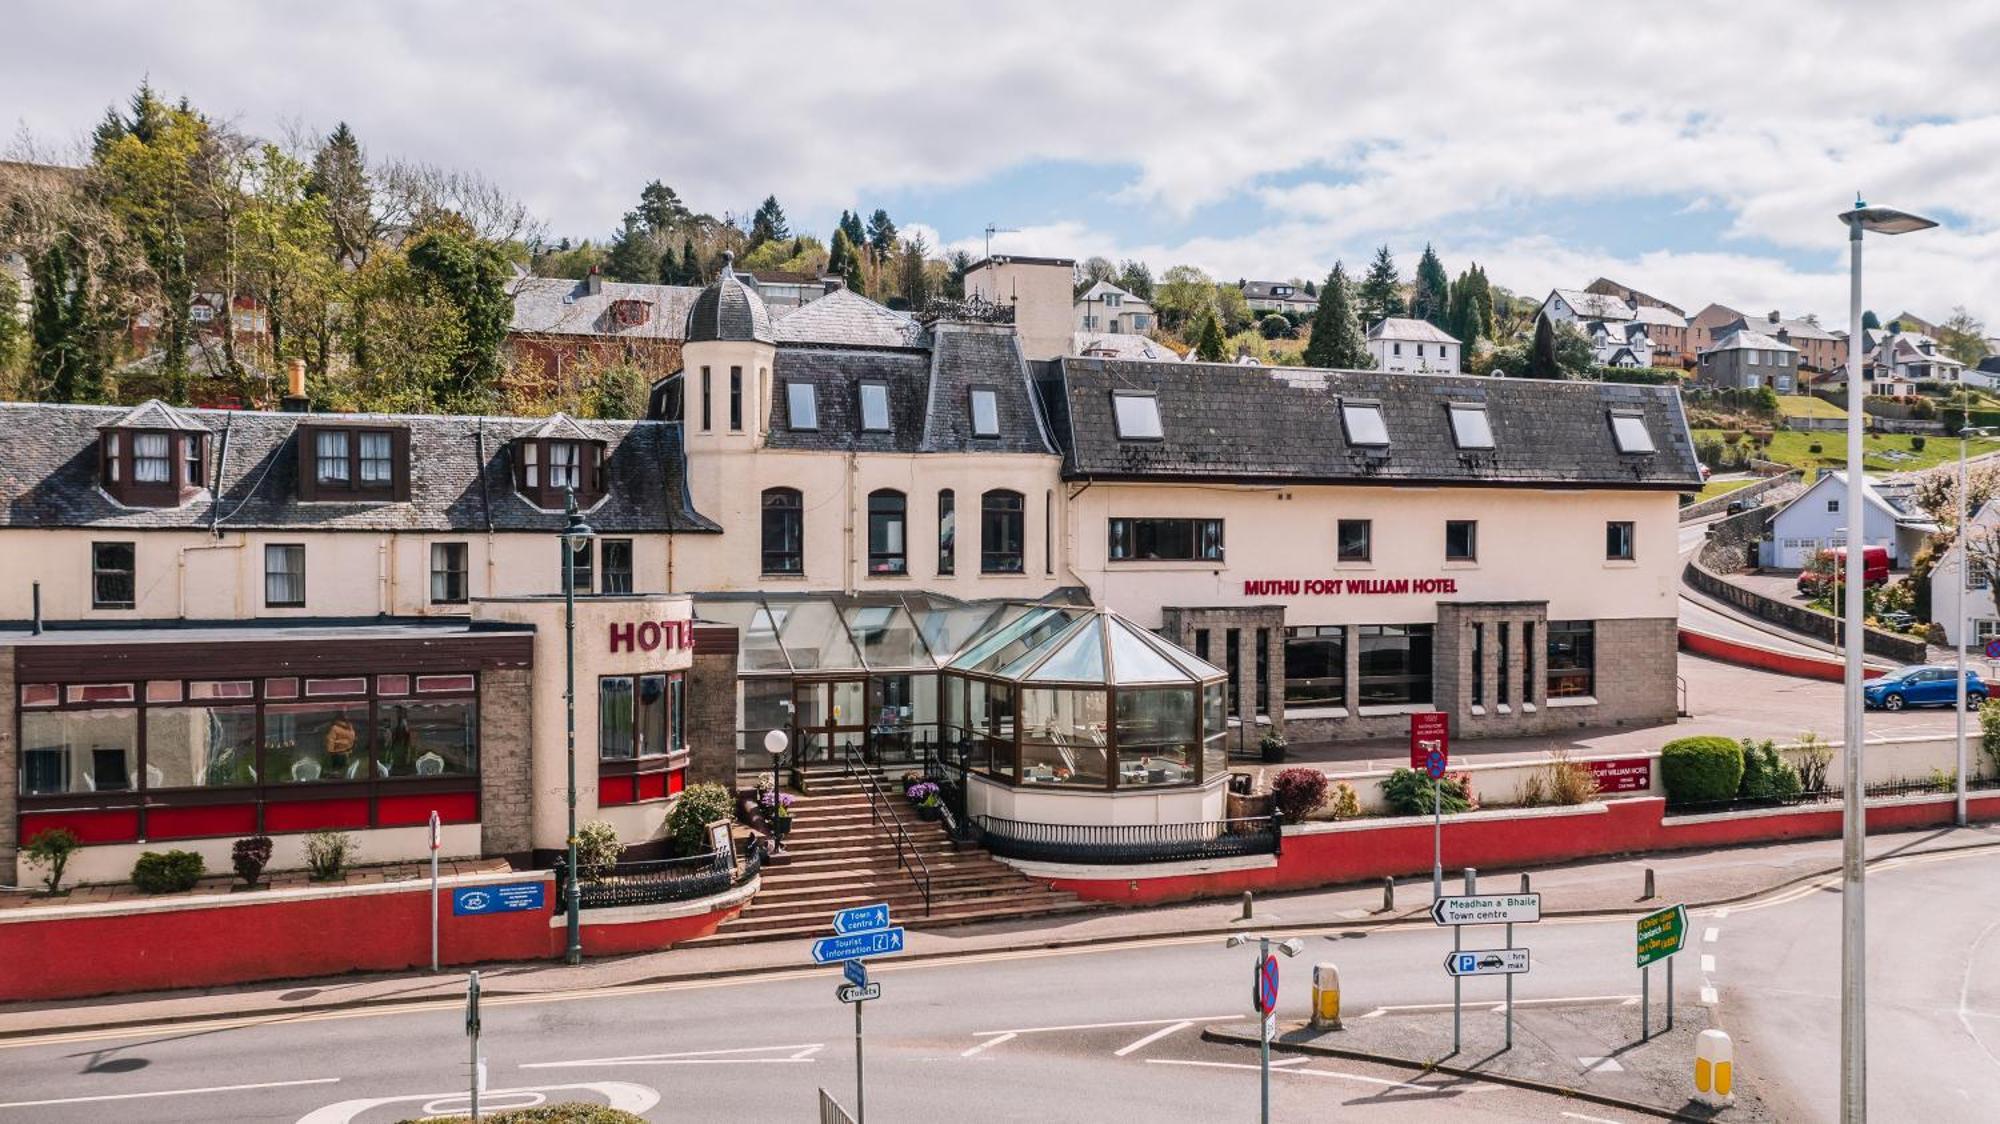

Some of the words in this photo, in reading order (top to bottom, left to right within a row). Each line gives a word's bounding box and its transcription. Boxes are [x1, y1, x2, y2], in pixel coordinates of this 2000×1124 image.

[1244, 580, 1300, 596] MUTHU
[1303, 580, 1343, 595] FORT
[1347, 580, 1409, 595] WILLIAM
[1413, 579, 1458, 594] HOTEL
[1608, 767, 1631, 776] WILLIAM
[1631, 766, 1648, 775] HOTEL
[1450, 899, 1493, 909] Meadhan
[1507, 898, 1537, 906] Bhaile
[851, 911, 871, 920] Town
[1449, 911, 1474, 920] Town
[1476, 910, 1508, 920] centre
[847, 920, 873, 929] centre
[835, 937, 862, 948] Tourist
[825, 945, 872, 958] information
